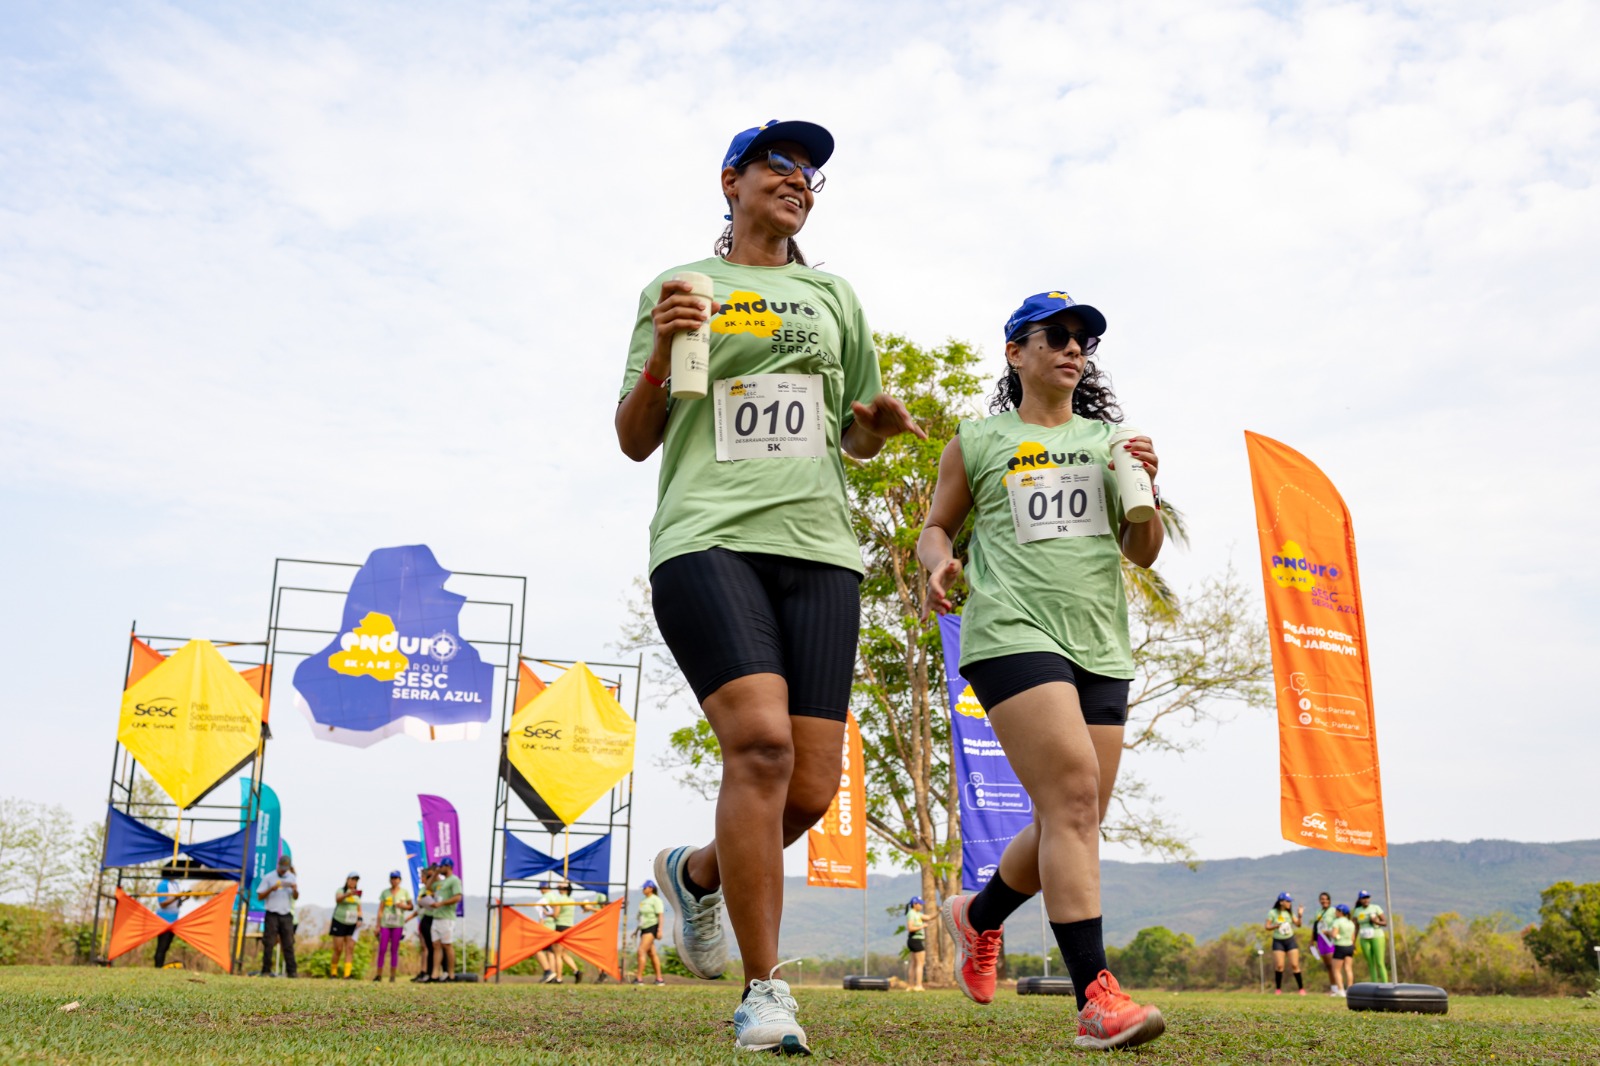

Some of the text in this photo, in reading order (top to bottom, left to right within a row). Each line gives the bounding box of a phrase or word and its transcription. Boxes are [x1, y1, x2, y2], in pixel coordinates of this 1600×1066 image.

[770, 320, 818, 331] PARQUE
[772, 330, 819, 344] SESC
[771, 344, 812, 354] SERRA
[734, 400, 804, 436] 010
[768, 444, 781, 452] 5K
[1008, 448, 1093, 470] enduro
[1028, 488, 1087, 520] 010
[340, 631, 457, 660] enduro
[366, 660, 374, 668] A
[394, 662, 448, 673] PARQUE
[394, 672, 448, 688] SESC
[392, 688, 482, 702] SERRA AZUL
[190, 702, 209, 711] Polo
[190, 712, 252, 724] Socioambiental
[189, 722, 246, 733] Sesc Pantanal
[574, 725, 590, 734] Polo
[572, 745, 590, 754] Sesc
[840, 774, 850, 788] o
[838, 791, 852, 836] com
[1302, 816, 1328, 832] Sesc
[1335, 818, 1348, 827] Polo
